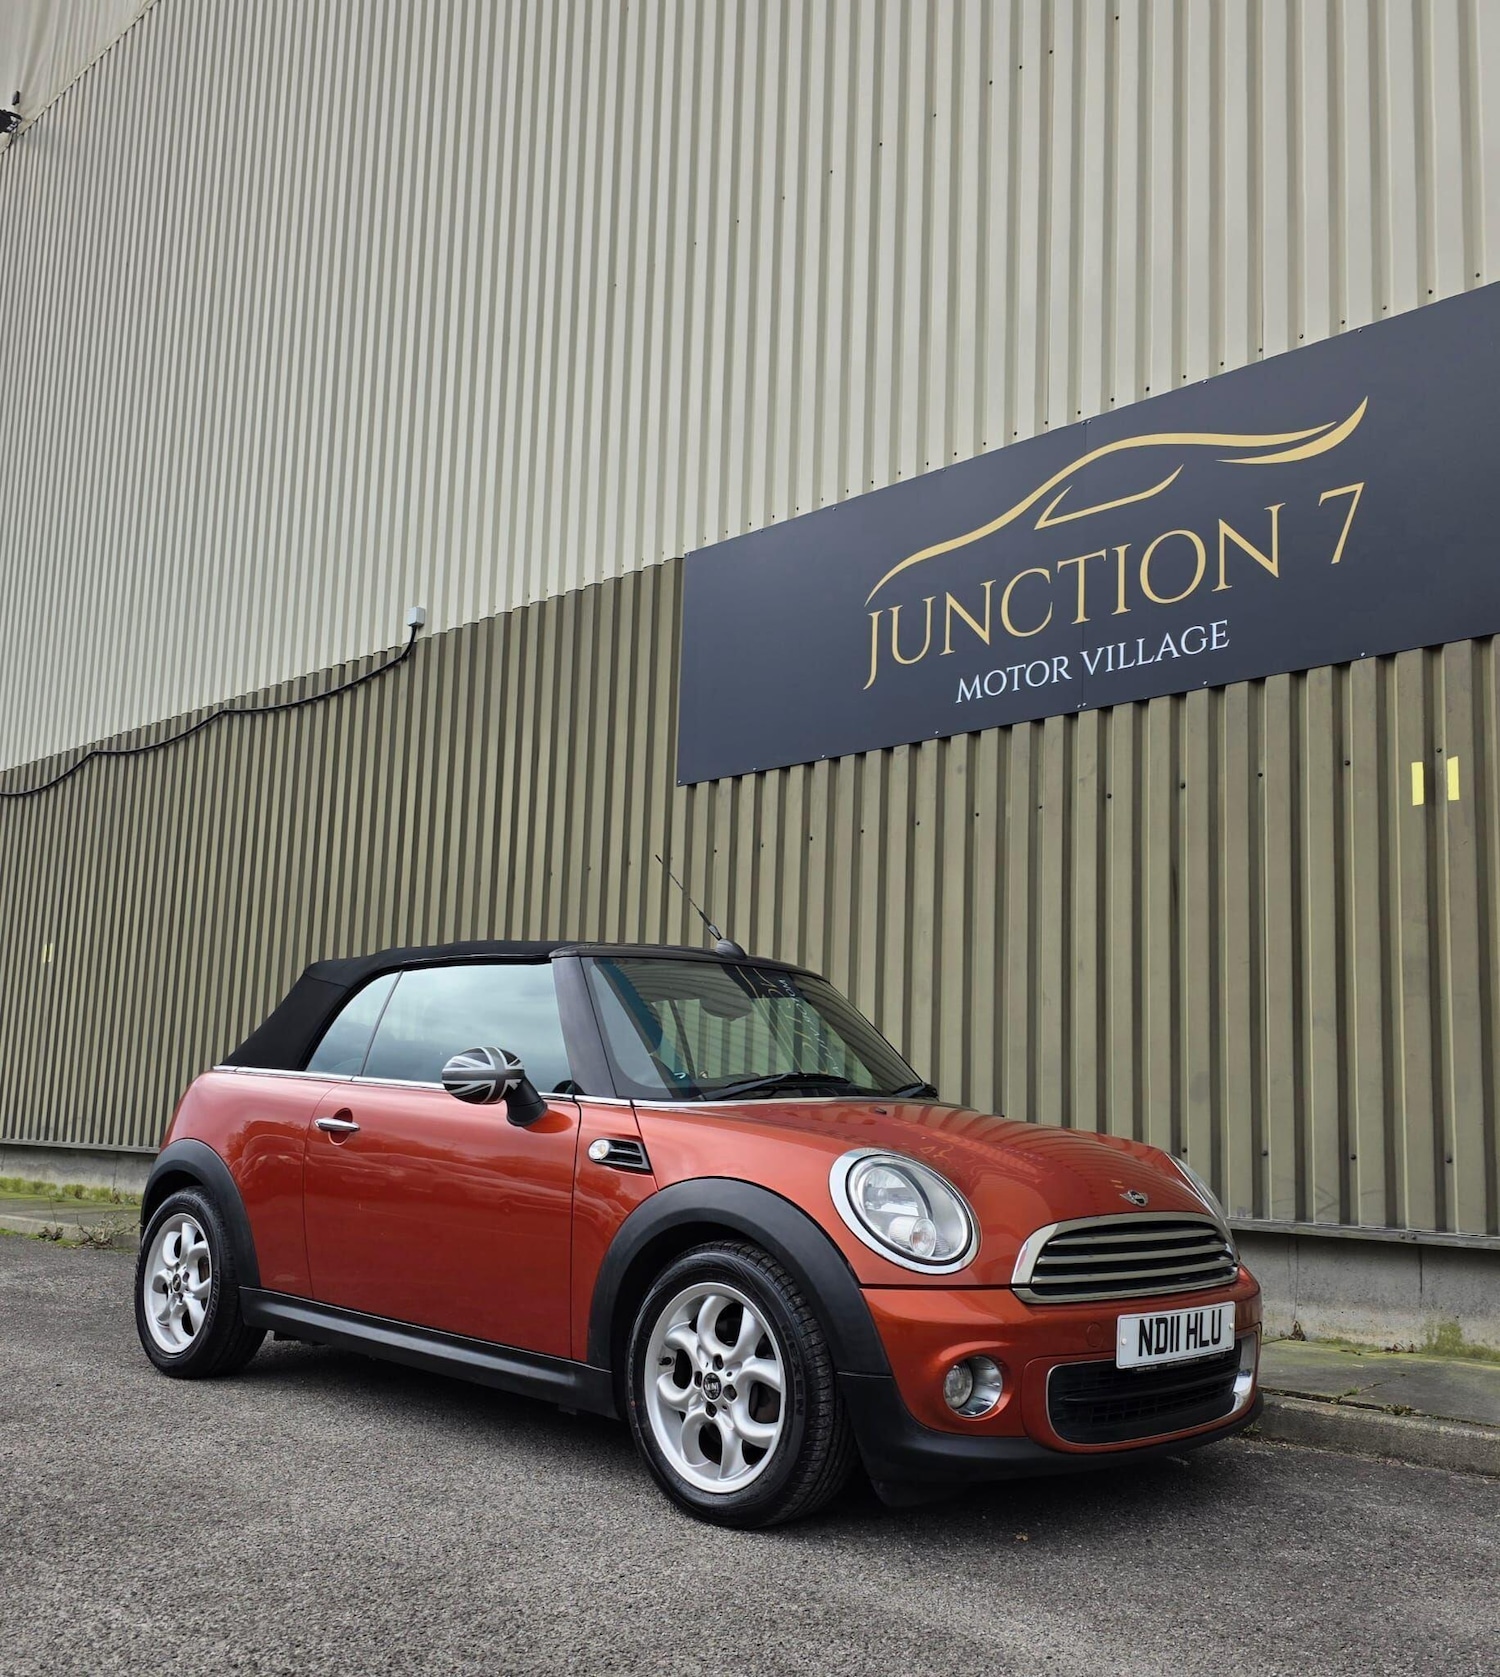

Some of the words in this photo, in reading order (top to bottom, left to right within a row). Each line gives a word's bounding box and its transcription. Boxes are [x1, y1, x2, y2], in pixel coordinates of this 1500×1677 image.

[863, 502, 1286, 690] JUNCTION
[1318, 481, 1366, 565] 7
[955, 655, 1073, 704] MOTOR
[1080, 619, 1231, 676] VILLAGE
[1138, 1316, 1181, 1357] ND11
[1186, 1309, 1223, 1350] HLU
